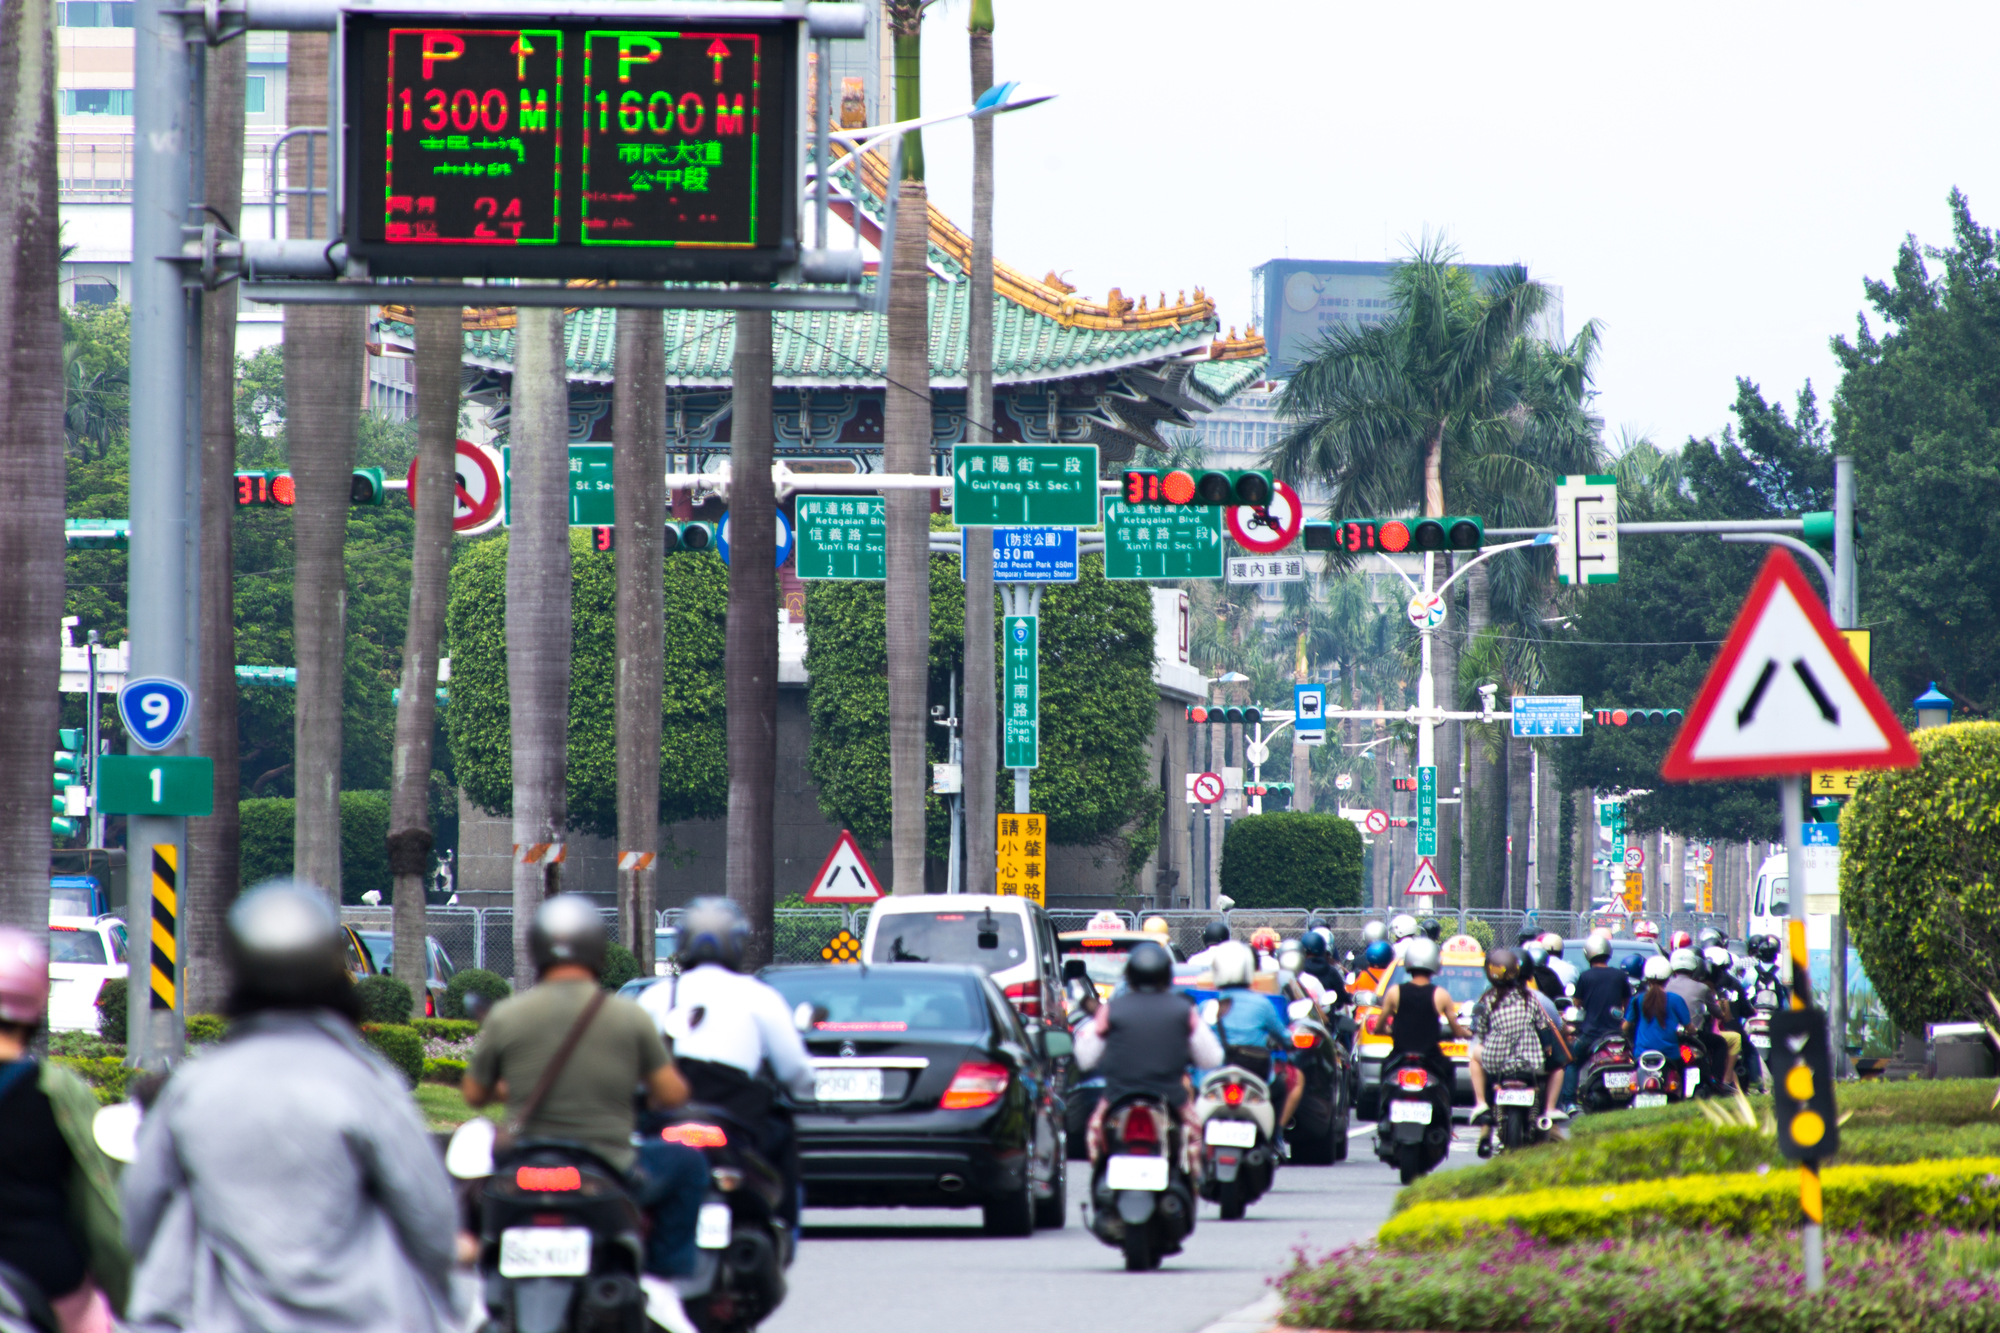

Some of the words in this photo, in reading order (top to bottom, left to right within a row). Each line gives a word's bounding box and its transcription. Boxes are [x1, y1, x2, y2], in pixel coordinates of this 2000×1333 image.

[423, 34, 465, 79] P
[619, 36, 662, 82] P
[400, 88, 508, 131] 1300
[519, 88, 548, 131] M
[595, 90, 705, 134] 1600
[716, 92, 745, 134] M
[970, 456, 1081, 473] 貴陽街一段
[238, 475, 266, 505] 31
[576, 481, 591, 490] St.
[596, 481, 614, 490] Se
[972, 480, 1021, 492] GuiYang
[1027, 480, 1042, 490] St.
[1047, 480, 1071, 490] Sec.
[1128, 472, 1158, 503] 31
[809, 528, 882, 541] 信義路一
[1117, 527, 1209, 541] 信義路一段
[1346, 523, 1375, 551] 31
[818, 543, 843, 551] XinYi
[1126, 542, 1151, 550] XinYi
[827, 565, 834, 576] 2
[1136, 566, 1142, 575] 2
[1017, 630, 1024, 638] 9
[1013, 645, 1028, 717] 中山南路
[141, 692, 170, 729] 9
[1007, 719, 1035, 728] Zhong
[1007, 727, 1029, 735] Shan
[149, 768, 161, 802] 1
[1626, 851, 1641, 861] 50
